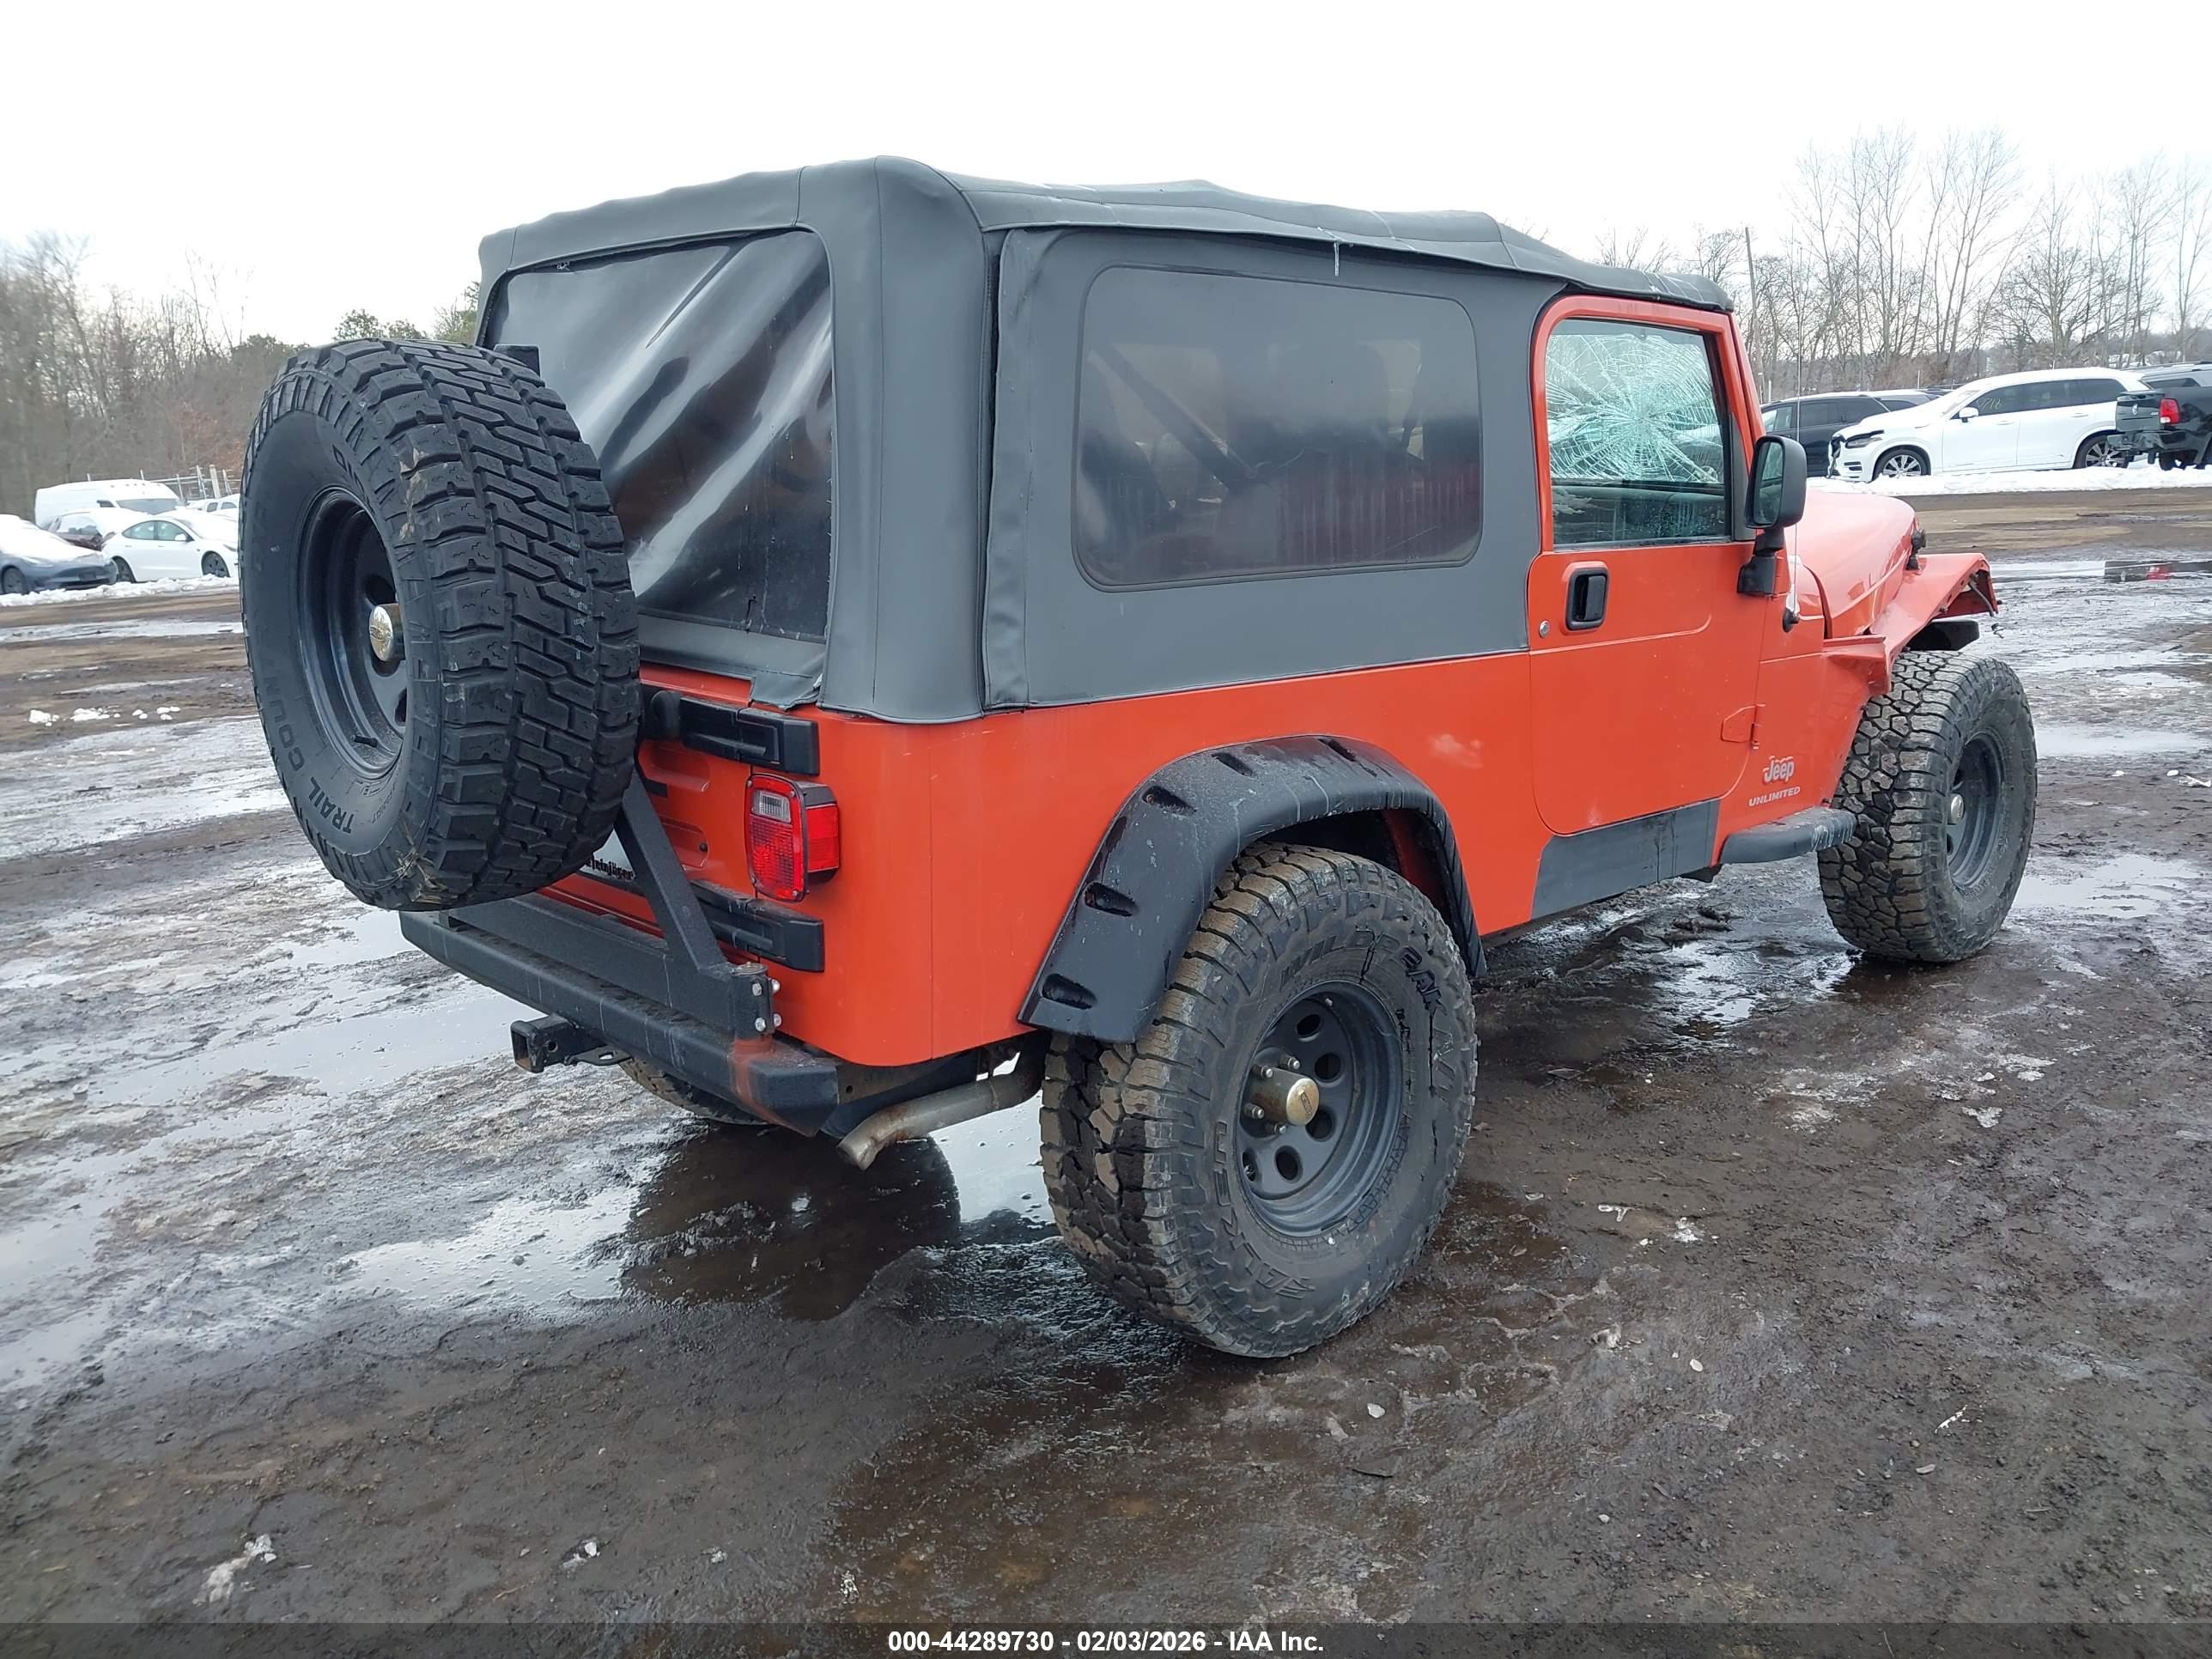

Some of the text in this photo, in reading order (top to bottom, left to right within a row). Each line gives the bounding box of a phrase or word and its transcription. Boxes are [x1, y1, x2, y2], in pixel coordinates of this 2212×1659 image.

[1763, 756, 1795, 782] Jeep
[308, 777, 355, 835] TRAIL
[1748, 786, 1801, 806] UNLIMITED
